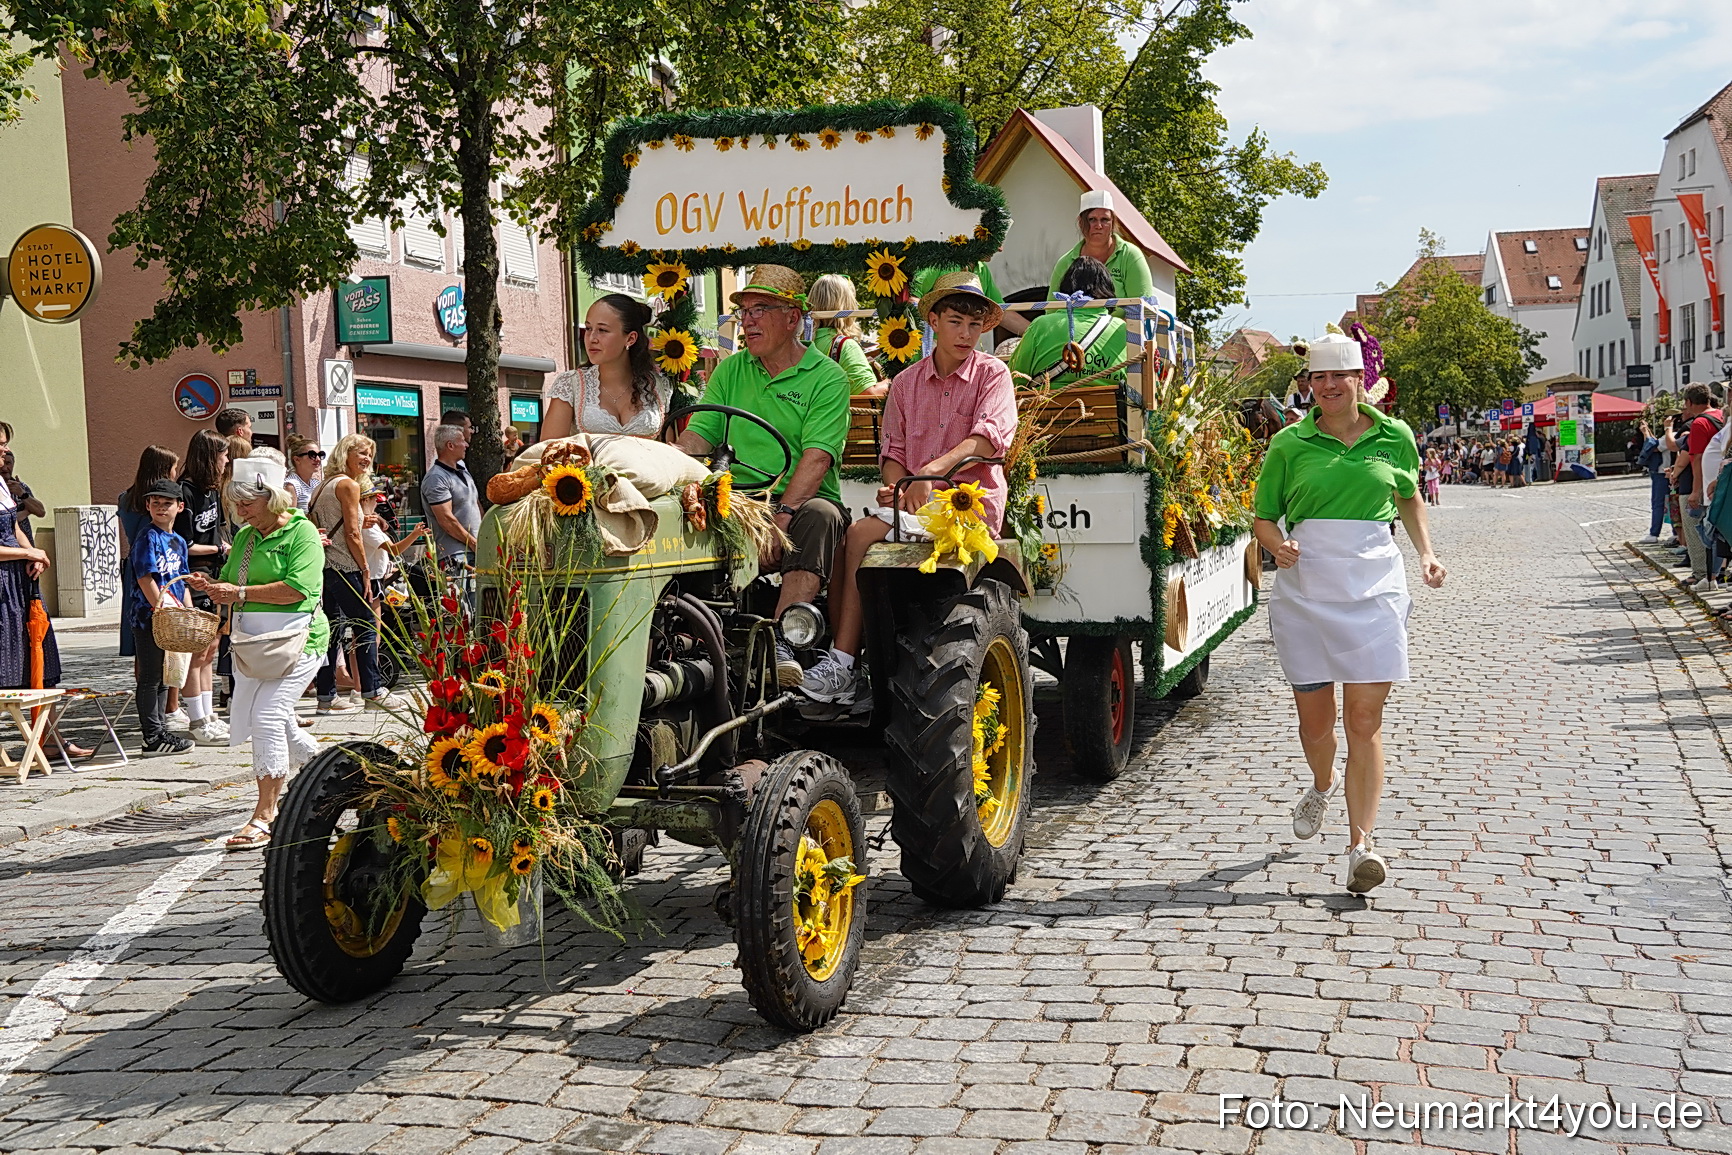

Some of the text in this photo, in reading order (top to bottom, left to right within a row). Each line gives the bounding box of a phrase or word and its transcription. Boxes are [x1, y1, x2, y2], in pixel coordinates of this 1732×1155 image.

[655, 183, 913, 239] OGV Woffenbach
[27, 243, 54, 252] STADT
[28, 252, 83, 267] HOTEL
[17, 245, 26, 297] MITTE
[29, 268, 62, 282] NEU
[30, 281, 84, 296] MARKT
[344, 288, 364, 303] vom
[351, 292, 382, 313] FASS
[436, 290, 456, 311] vom
[444, 304, 467, 331] FAS
[1084, 352, 1111, 368] OGV
[231, 386, 280, 397] Bockwirtsgasse
[787, 390, 803, 400] OGV
[332, 395, 348, 404] ZONE
[357, 392, 418, 412] Spirituosen Whisky
[513, 402, 536, 418] Essig Öl
[1491, 410, 1498, 419] P
[1524, 404, 1532, 415] P
[1376, 449, 1391, 459] OGV
[661, 537, 672, 552] 14
